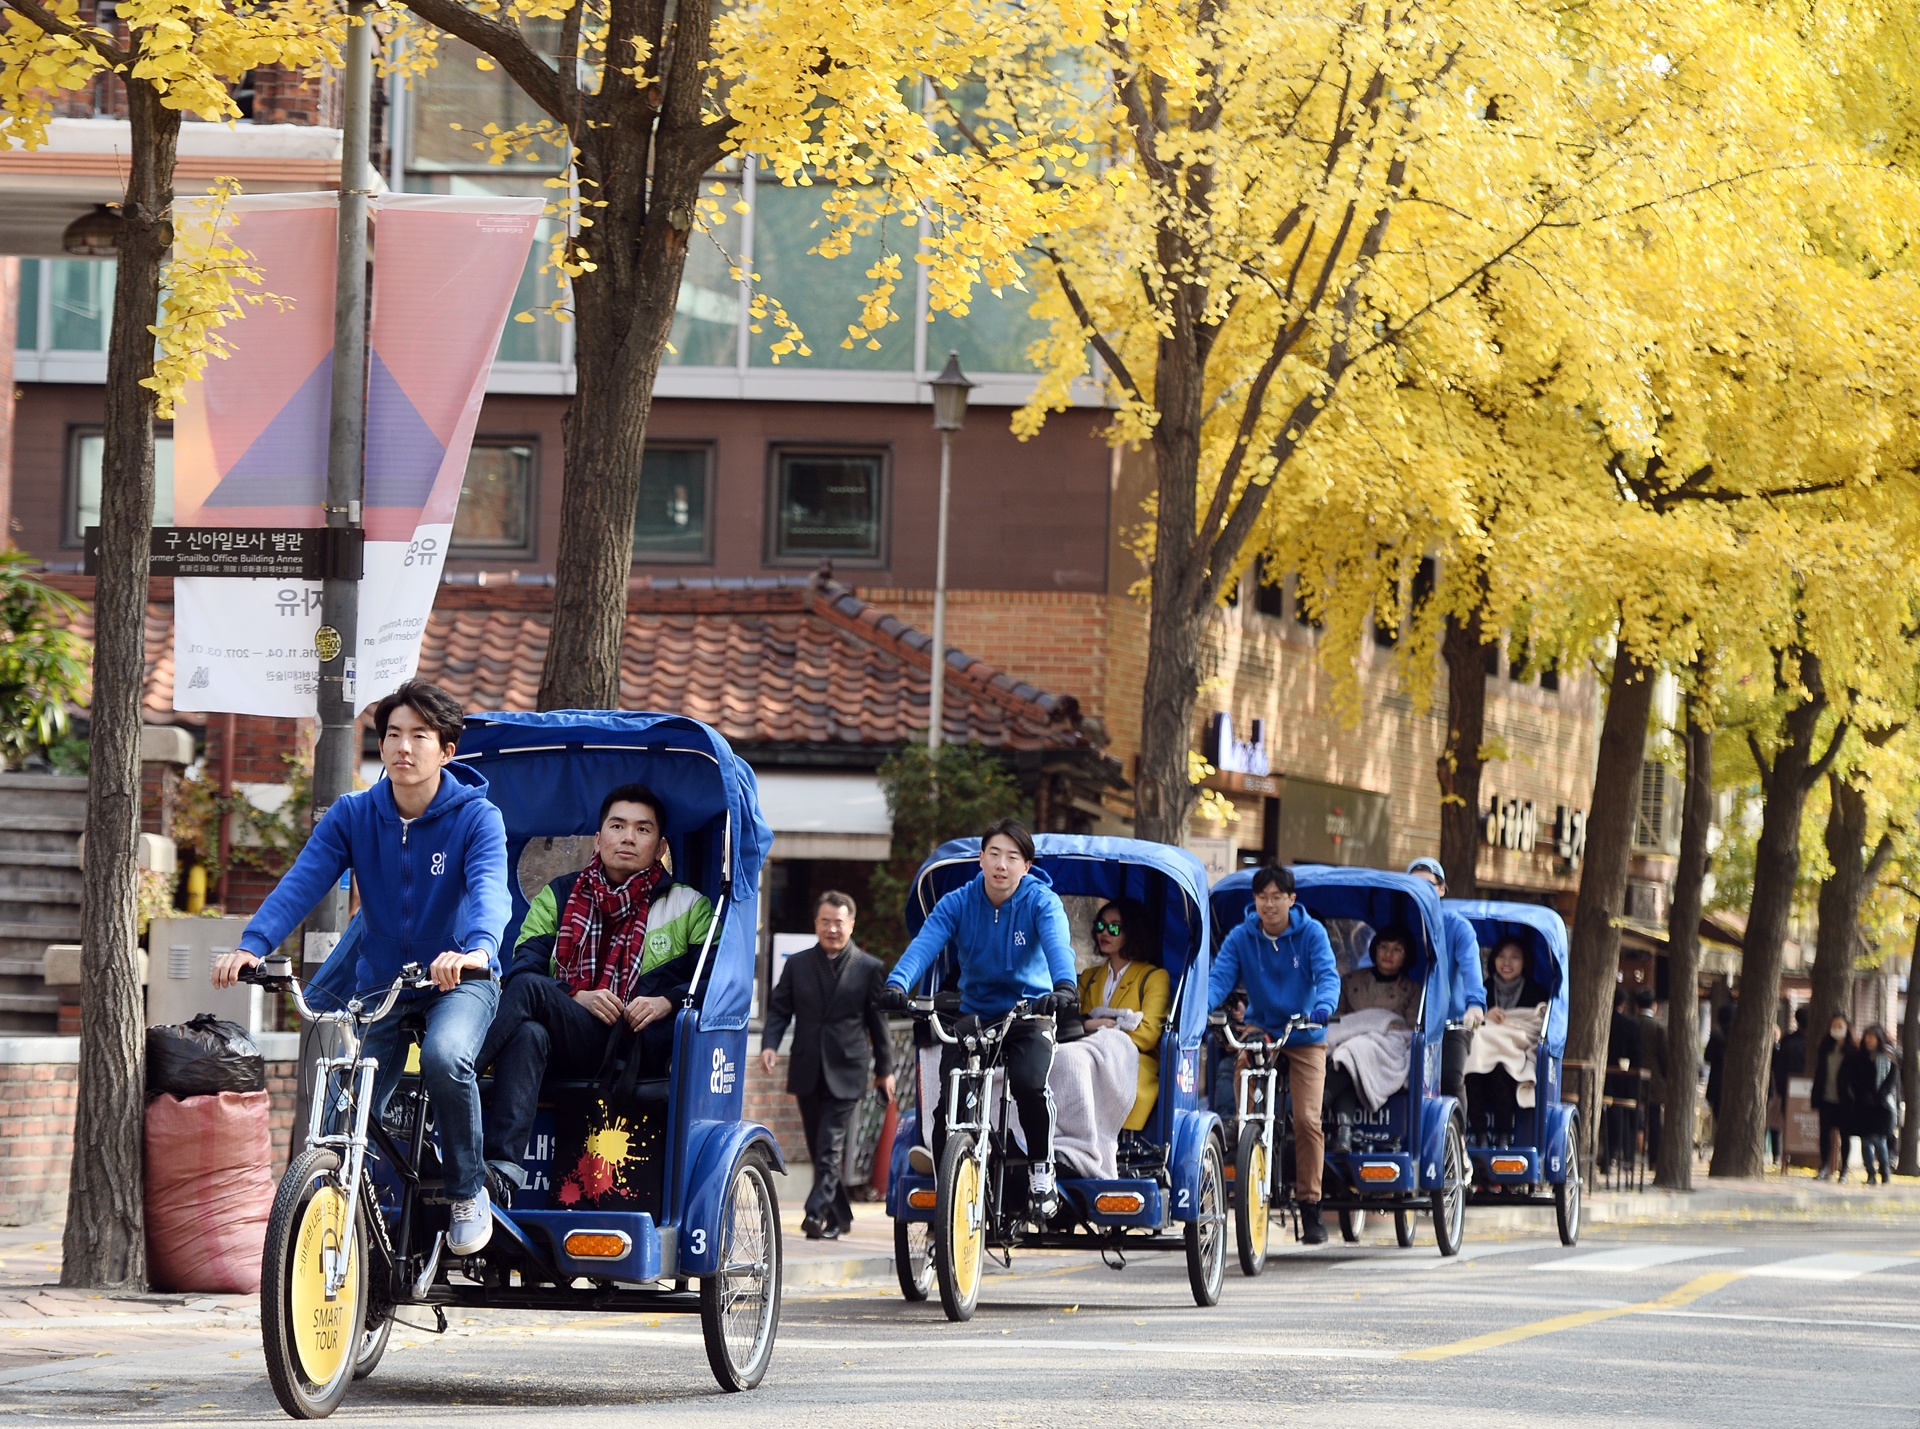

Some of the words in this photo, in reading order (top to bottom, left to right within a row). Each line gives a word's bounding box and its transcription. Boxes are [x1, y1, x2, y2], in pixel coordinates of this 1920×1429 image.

[165, 532, 182, 550] 구
[187, 532, 266, 551] 신아일보사
[271, 532, 304, 551] 별관
[149, 554, 175, 563] ormer
[176, 553, 210, 563] Sinailbo
[212, 553, 238, 563] Office
[240, 553, 274, 565] Building
[276, 554, 303, 563] Annex
[1426, 1163, 1437, 1181] 4
[1550, 1155, 1561, 1173] 5
[1178, 1188, 1190, 1208] 2
[690, 1228, 707, 1255] 3
[312, 1306, 343, 1329] SMART
[315, 1329, 338, 1352] TOUR
